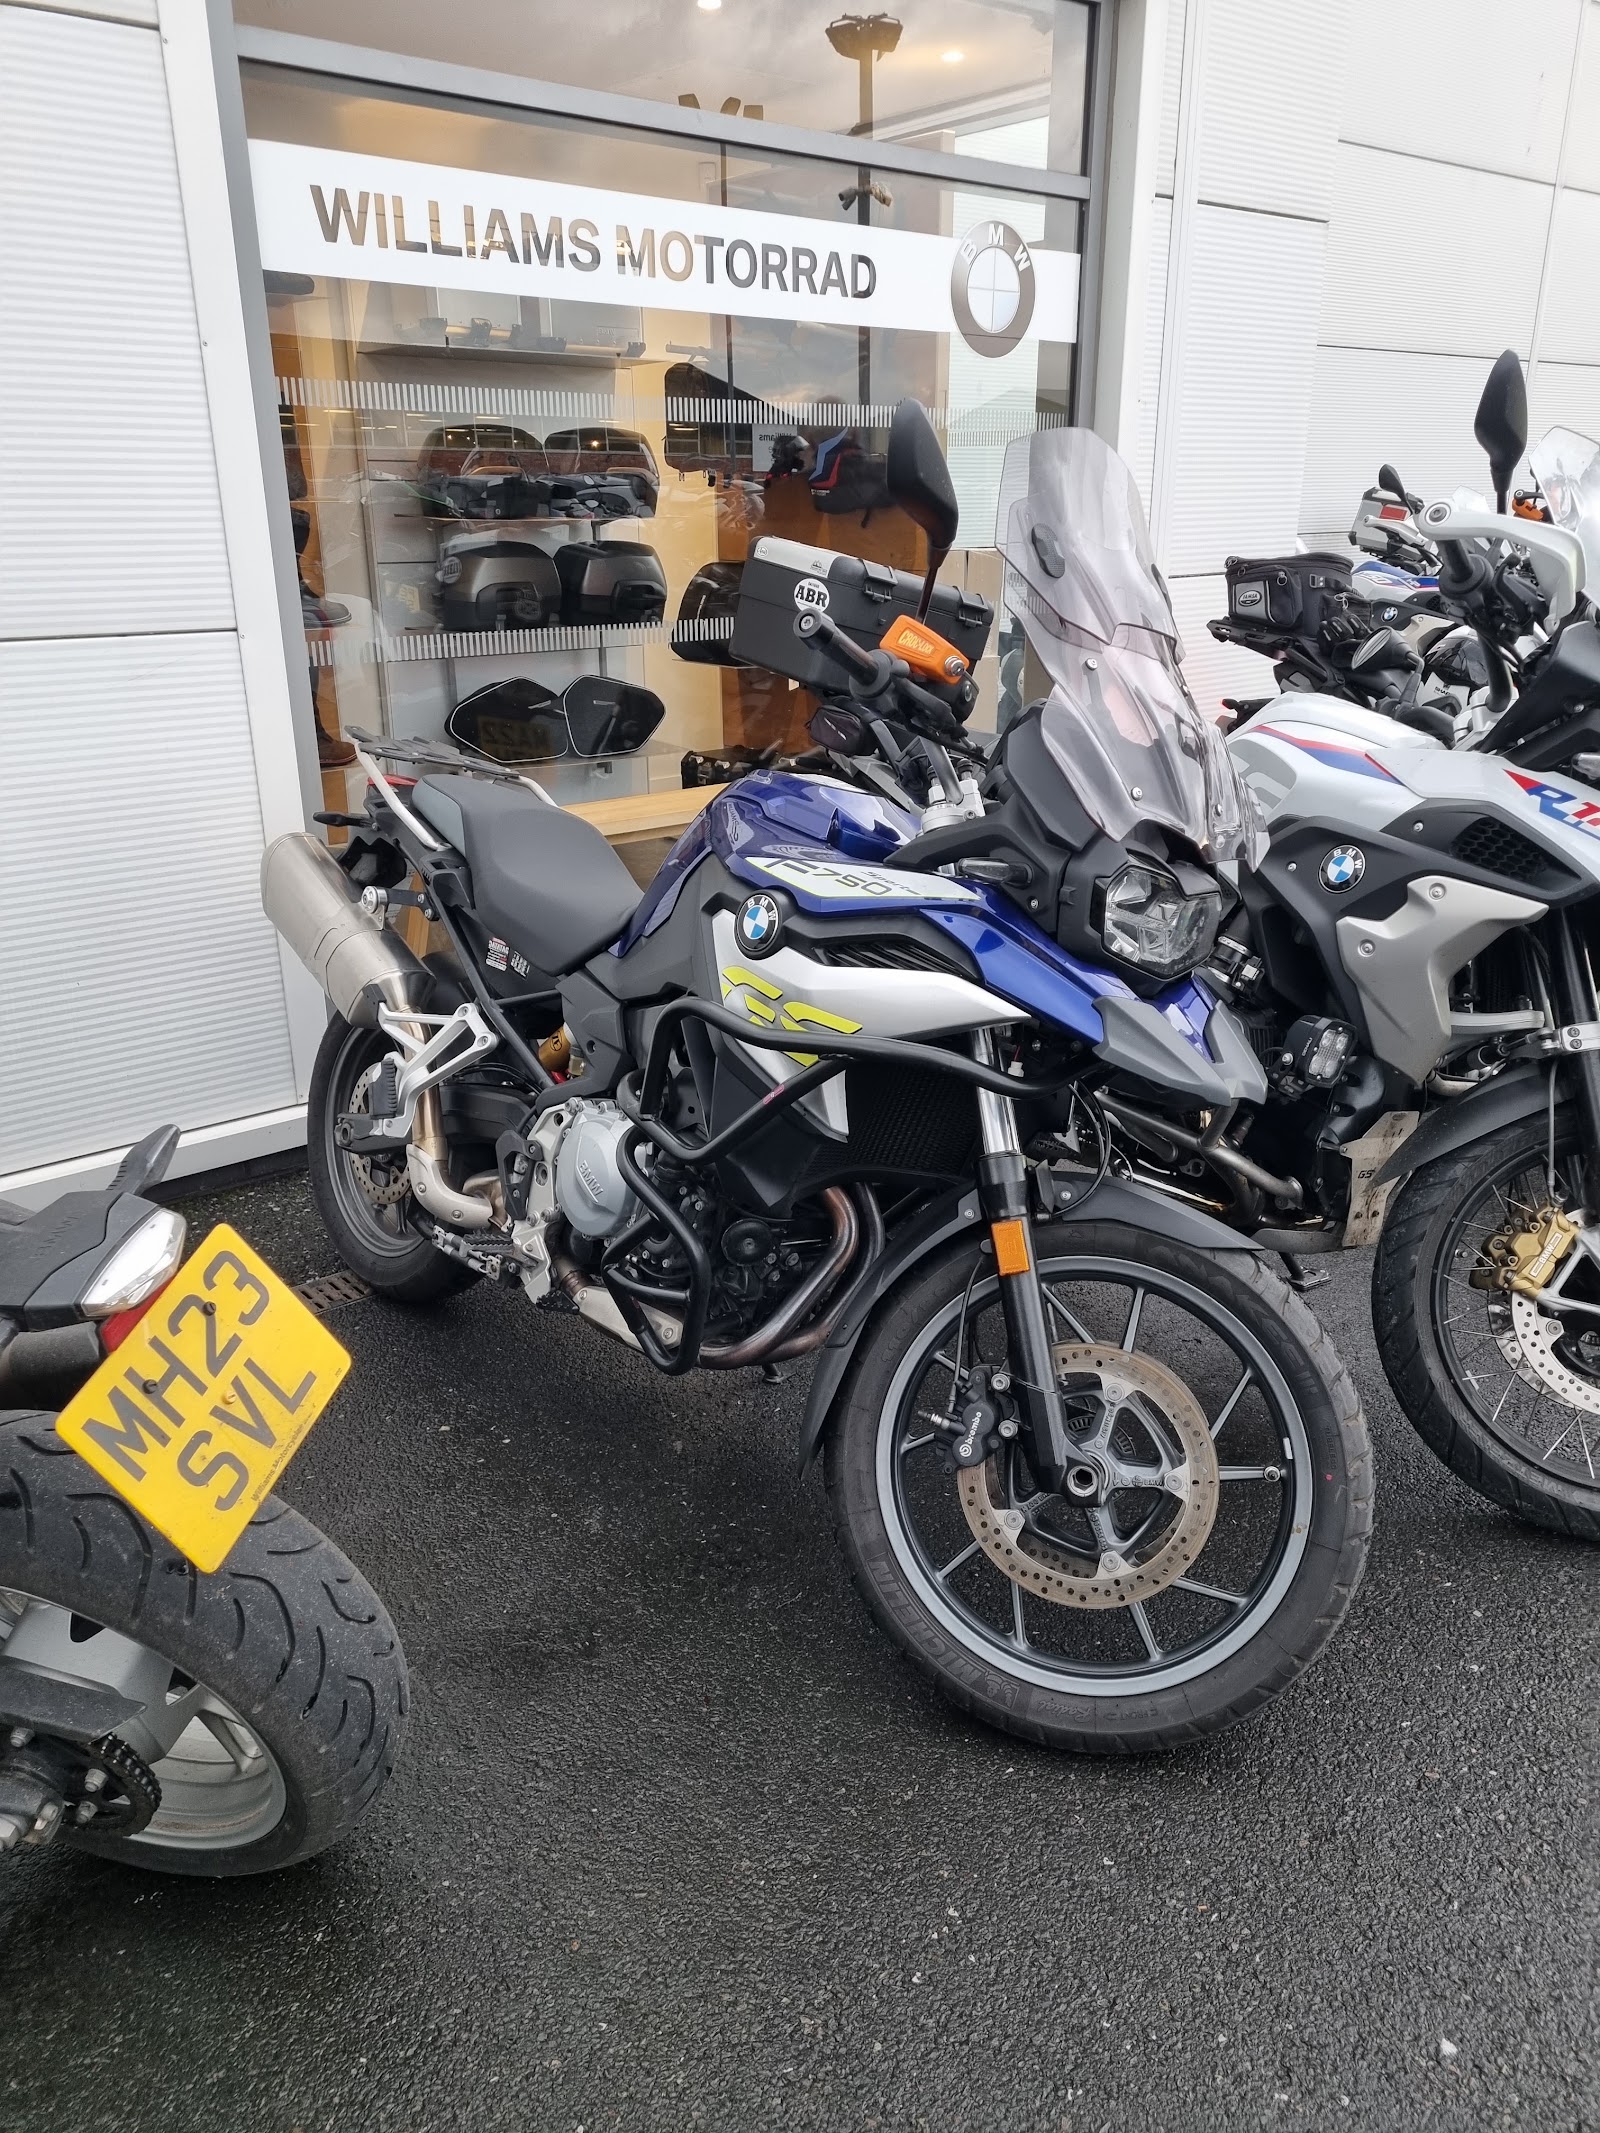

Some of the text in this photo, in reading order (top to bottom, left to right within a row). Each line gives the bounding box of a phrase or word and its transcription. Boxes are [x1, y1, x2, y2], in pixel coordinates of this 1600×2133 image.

[309, 184, 877, 299] WILLIAMS MOTORRAD
[960, 222, 1031, 272] BMW
[795, 585, 828, 607] ABR
[580, 1160, 604, 1196] BMW
[1357, 1169, 1376, 1178] GS
[1538, 1242, 1555, 1265] BMW
[81, 1250, 270, 1482] MH23
[177, 1357, 317, 1512] SVL
[965, 1411, 982, 1445] brembo
[866, 1559, 983, 1686] MICHELIN
